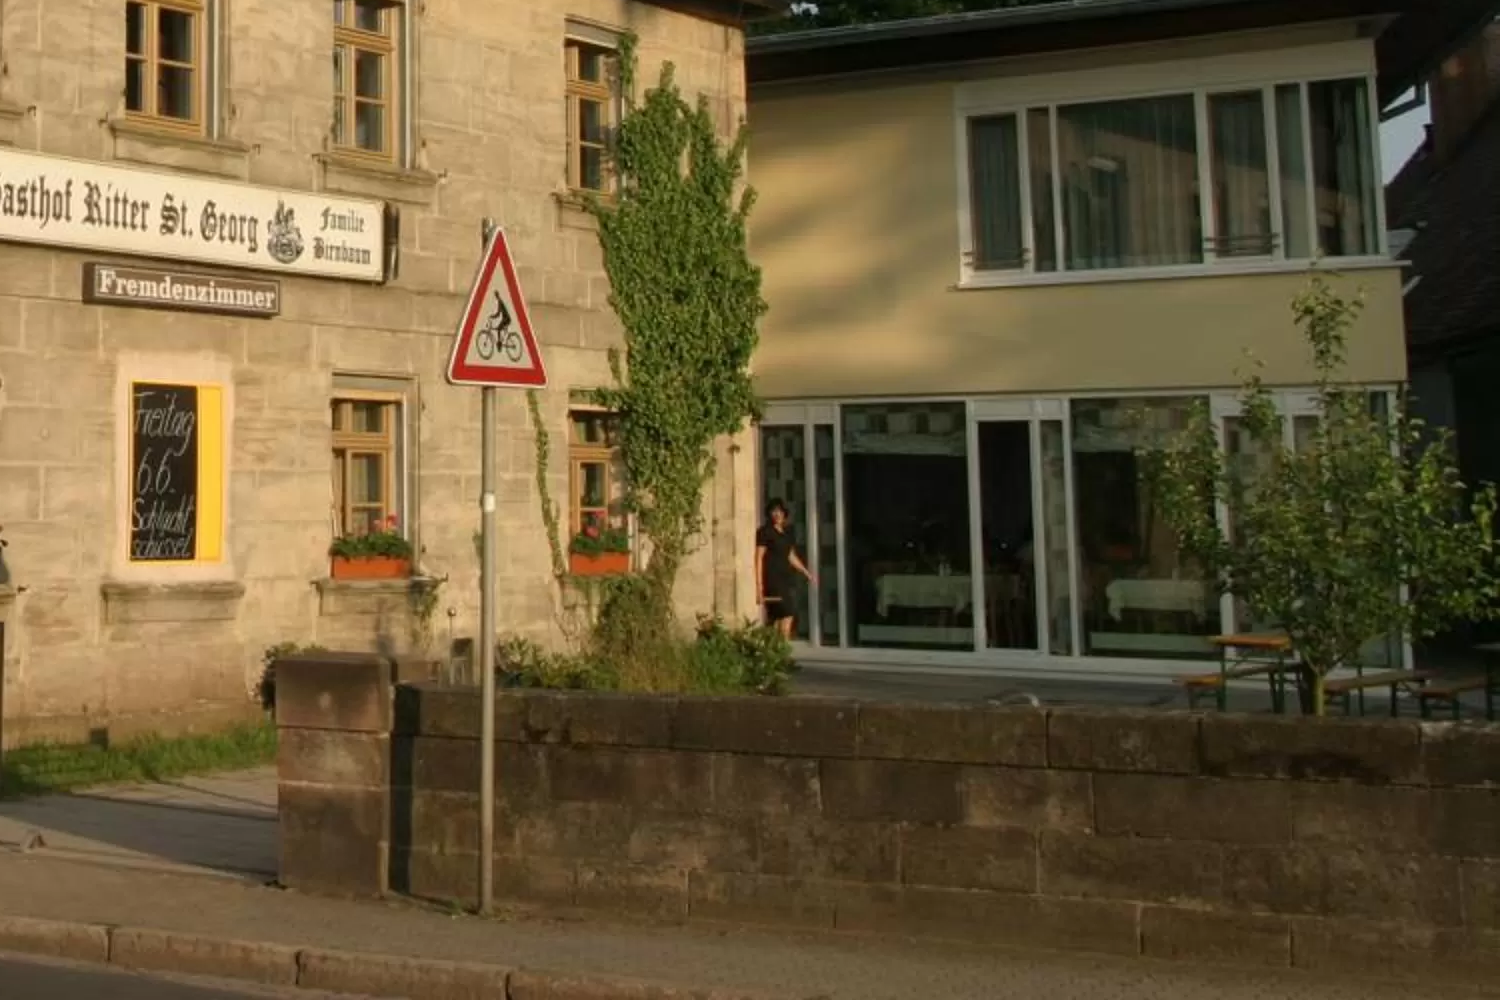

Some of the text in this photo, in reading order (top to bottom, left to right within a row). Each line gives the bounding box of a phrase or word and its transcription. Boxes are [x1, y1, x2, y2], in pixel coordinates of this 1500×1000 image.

[82, 179, 151, 233] Ritter
[159, 192, 194, 240] St.
[200, 200, 258, 252] Georg
[320, 206, 365, 232] Familie
[313, 236, 371, 265] Birnbaum
[100, 270, 276, 310] Fremdenzimmer
[133, 391, 195, 457] Freitag
